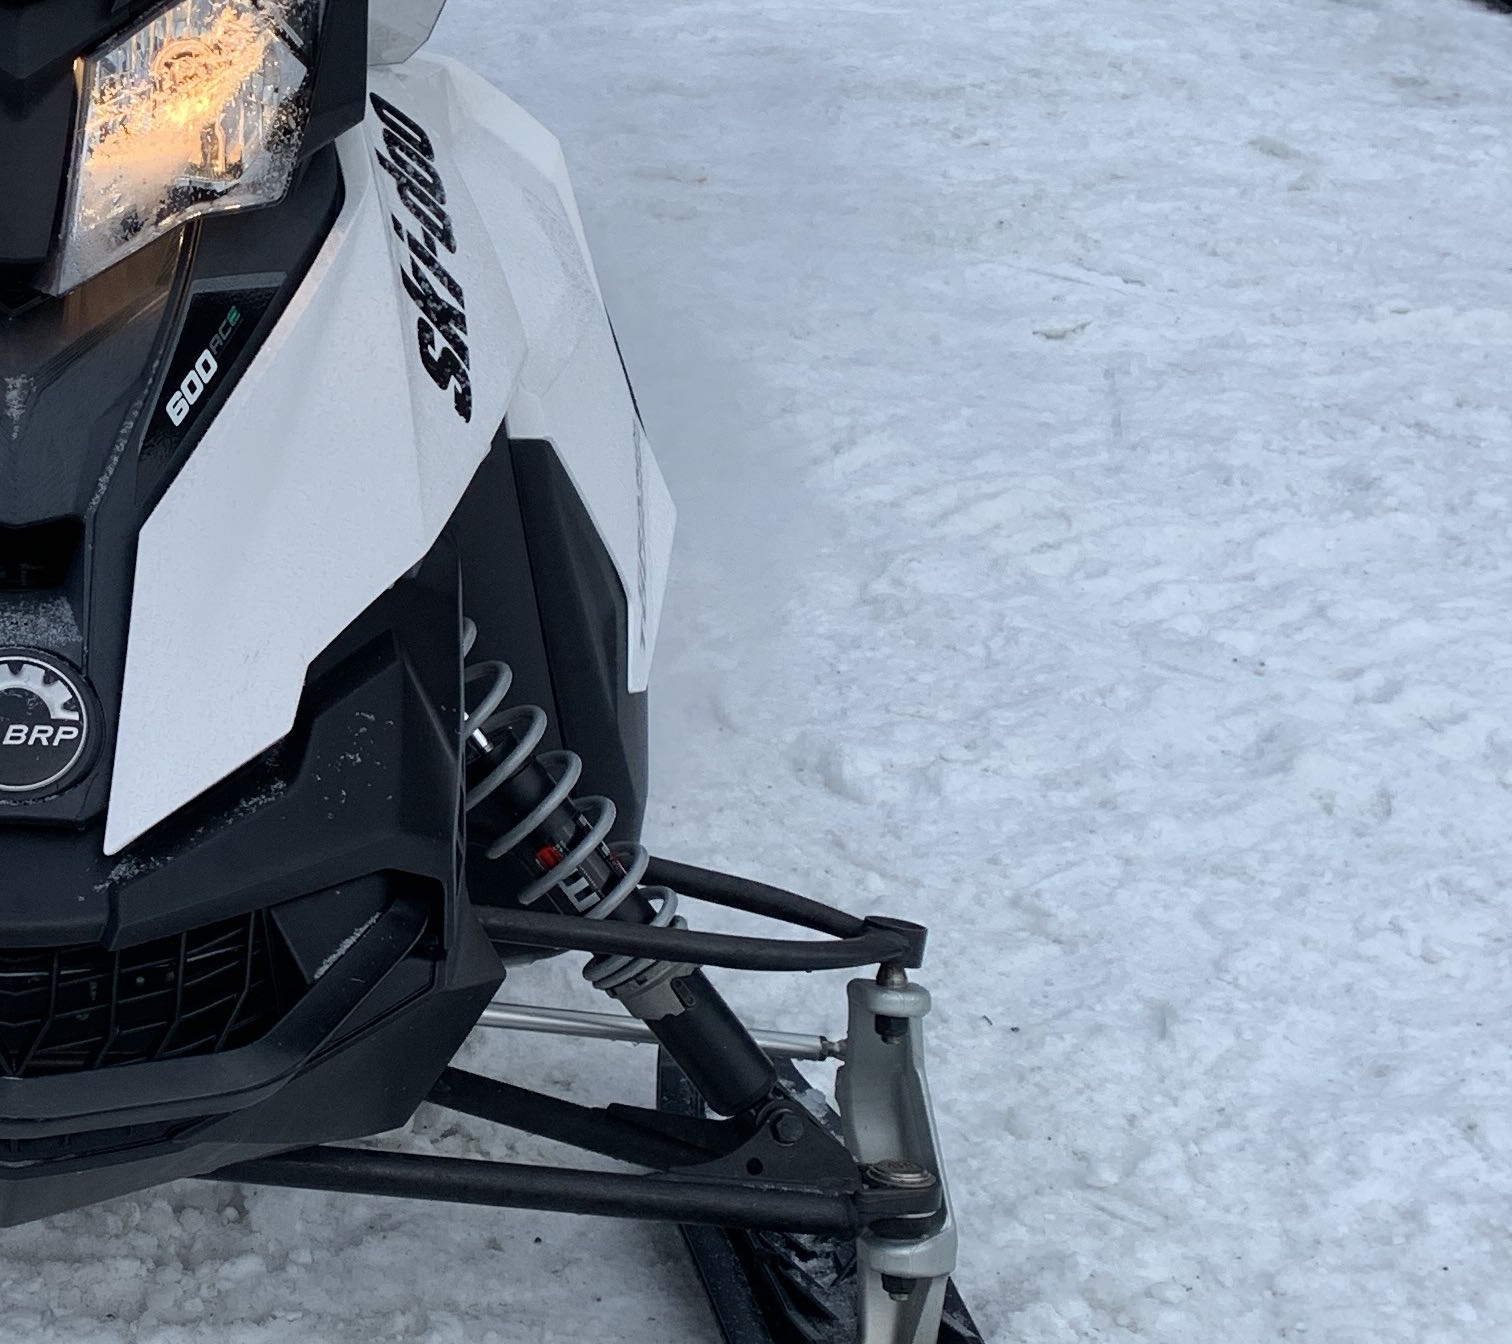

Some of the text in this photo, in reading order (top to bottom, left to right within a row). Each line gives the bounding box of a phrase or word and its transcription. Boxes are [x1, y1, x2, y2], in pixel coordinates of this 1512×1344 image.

[369, 91, 472, 424] ski-doo
[165, 305, 241, 427] 600 ACE
[2, 723, 79, 746] BRP
